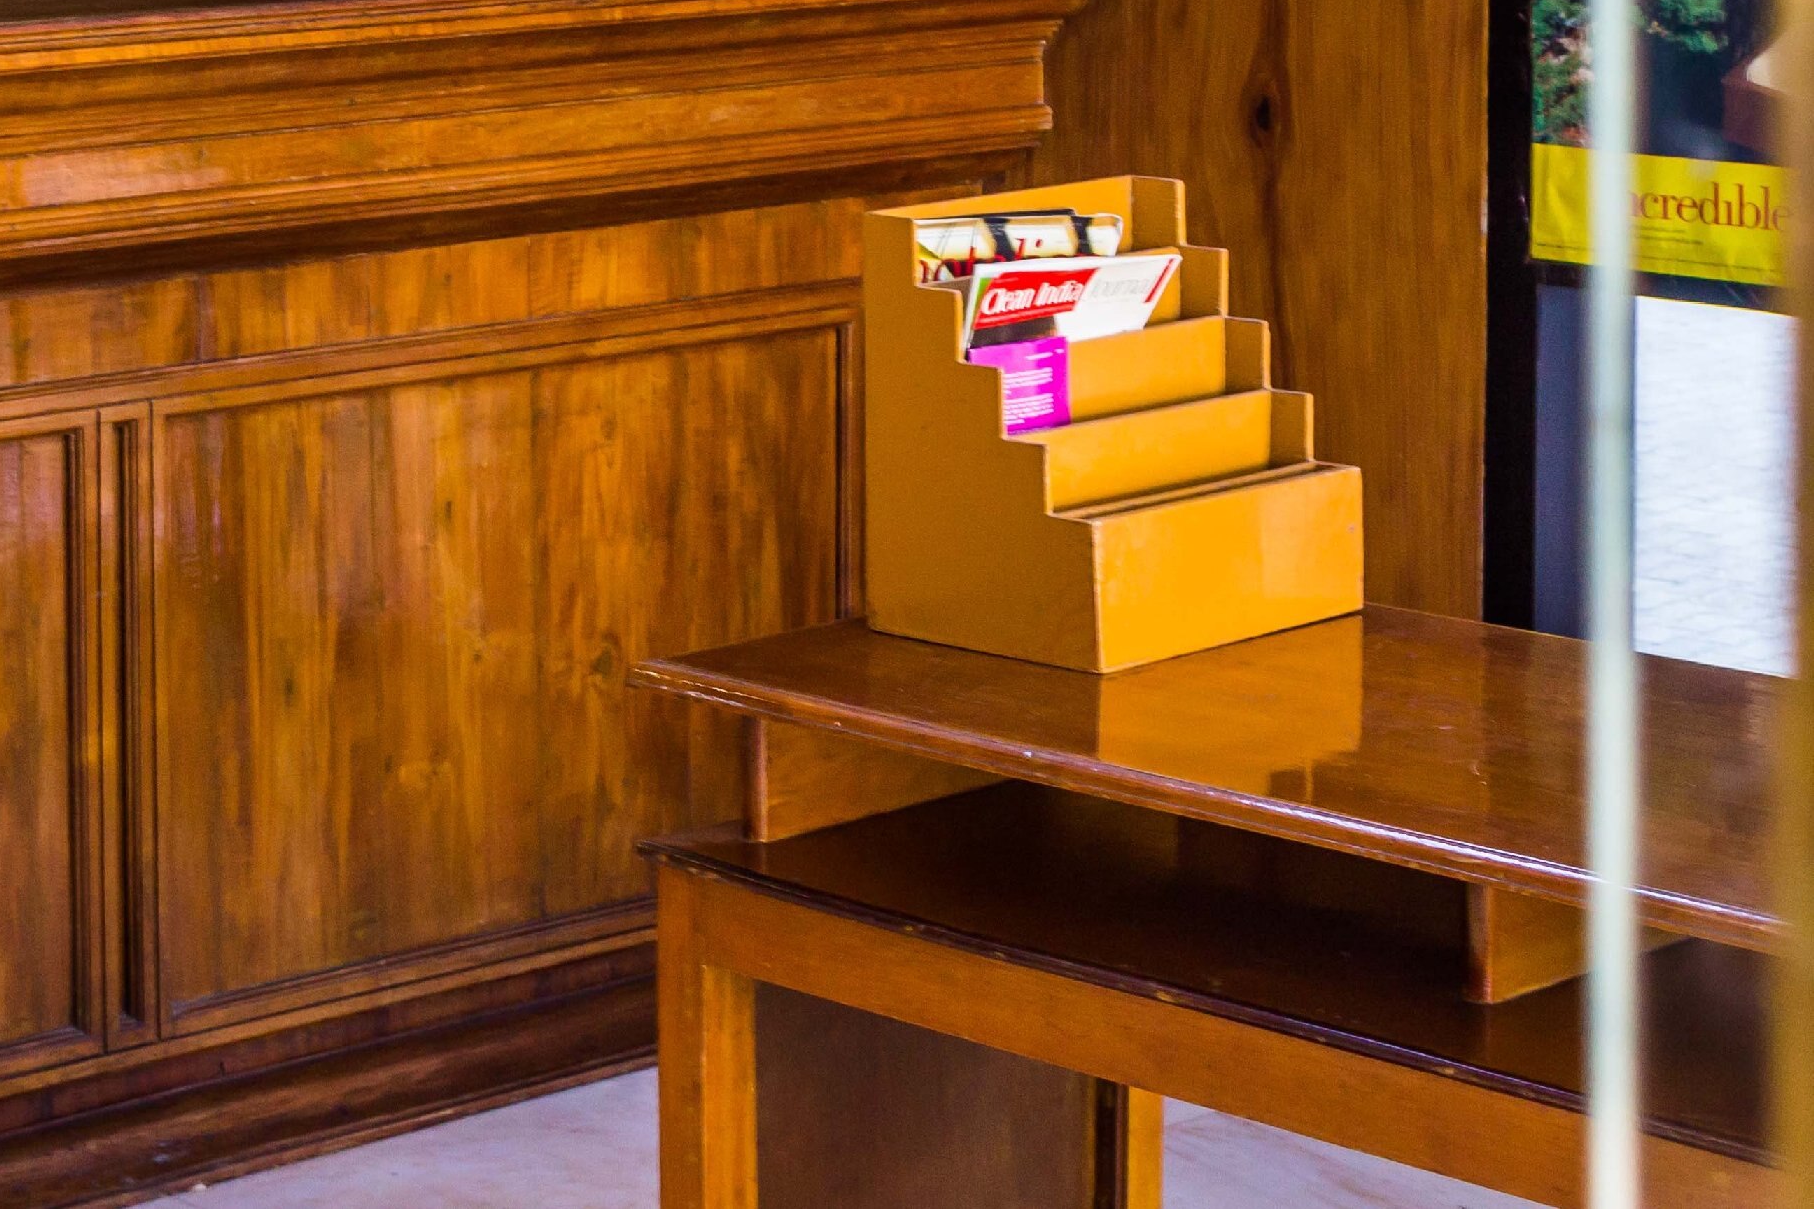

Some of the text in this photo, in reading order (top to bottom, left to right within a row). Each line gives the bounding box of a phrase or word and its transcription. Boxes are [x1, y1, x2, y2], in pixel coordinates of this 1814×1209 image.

[1628, 181, 1789, 231] credible
[982, 288, 1035, 315] Clean
[1033, 281, 1085, 306] India
